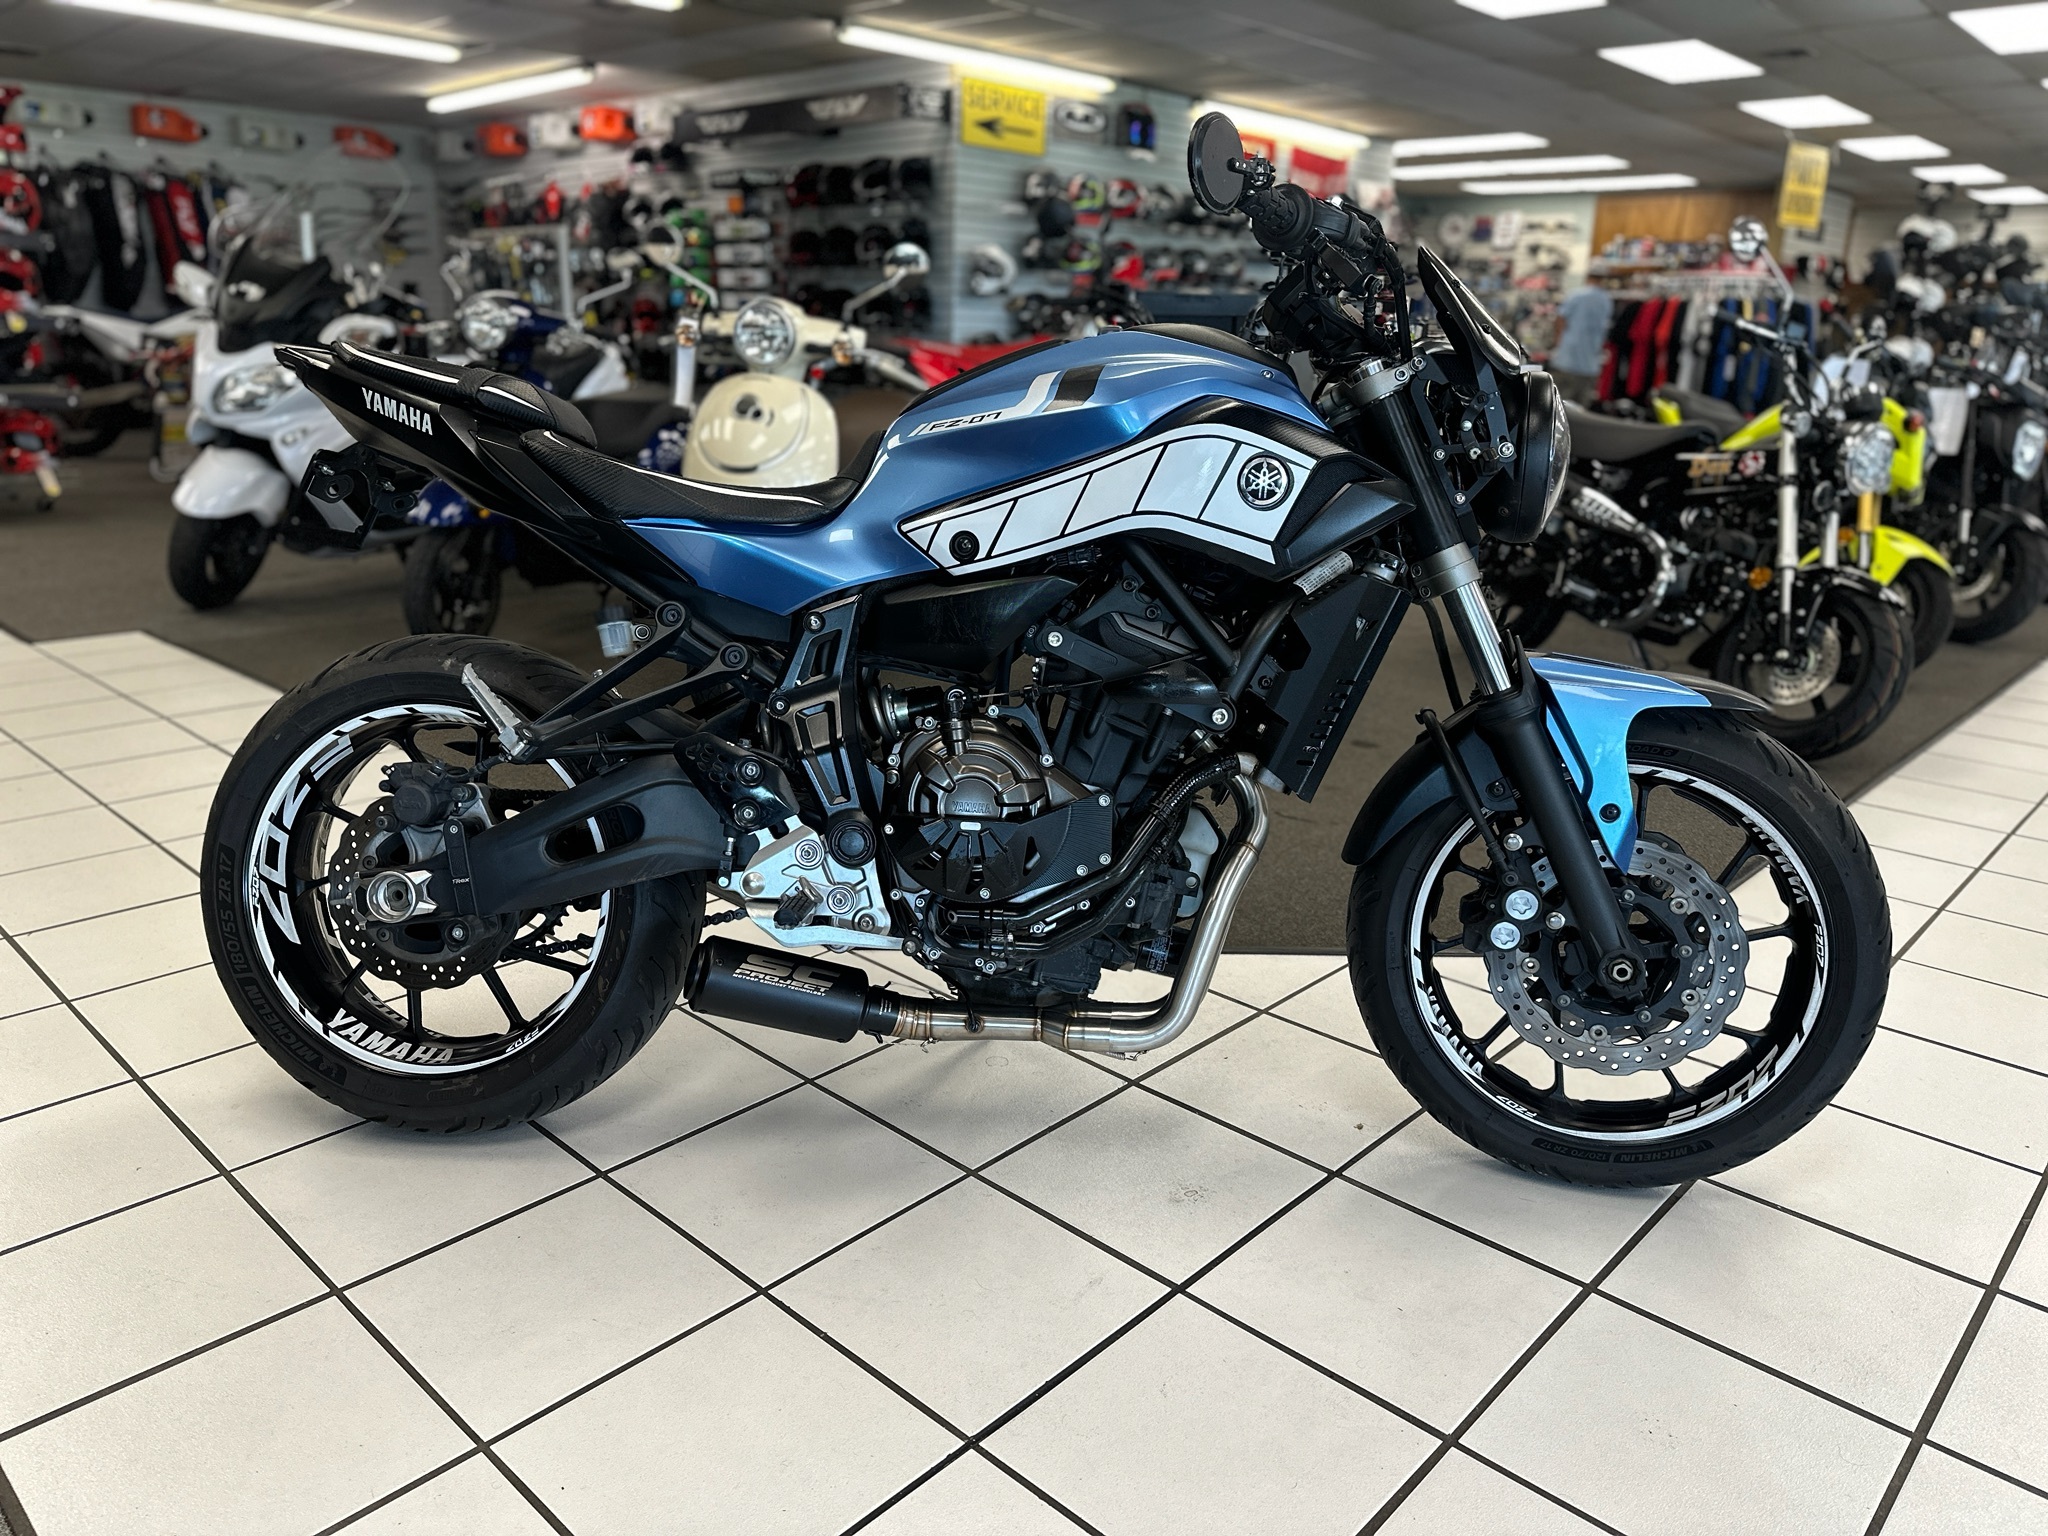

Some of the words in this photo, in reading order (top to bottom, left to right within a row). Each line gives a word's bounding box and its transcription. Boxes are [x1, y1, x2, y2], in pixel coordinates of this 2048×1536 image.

[965, 80, 1041, 120] SERVICE
[361, 386, 433, 436] YAMAHA
[929, 411, 1002, 431] FZ-07
[953, 800, 991, 814] YAMAHA
[259, 734, 354, 945] FZ07
[219, 851, 233, 873] 17
[218, 877, 232, 904] ZR
[219, 908, 248, 973] 180/55
[1813, 922, 1825, 968] FZ07
[734, 968, 830, 993] PROJECT
[739, 953, 841, 988] SC
[244, 984, 320, 1063] MICHELIN
[327, 1008, 454, 1065] YAMAHA
[1427, 985, 1484, 1078] YAMAHA
[505, 1026, 541, 1054] FZ07
[1496, 1094, 1538, 1119] FZ07
[1539, 1141, 1553, 1151] 17
[1553, 1145, 1569, 1155] ZR
[1571, 1149, 1608, 1162] 120/70
[1619, 1145, 1688, 1163] MICHELIN
